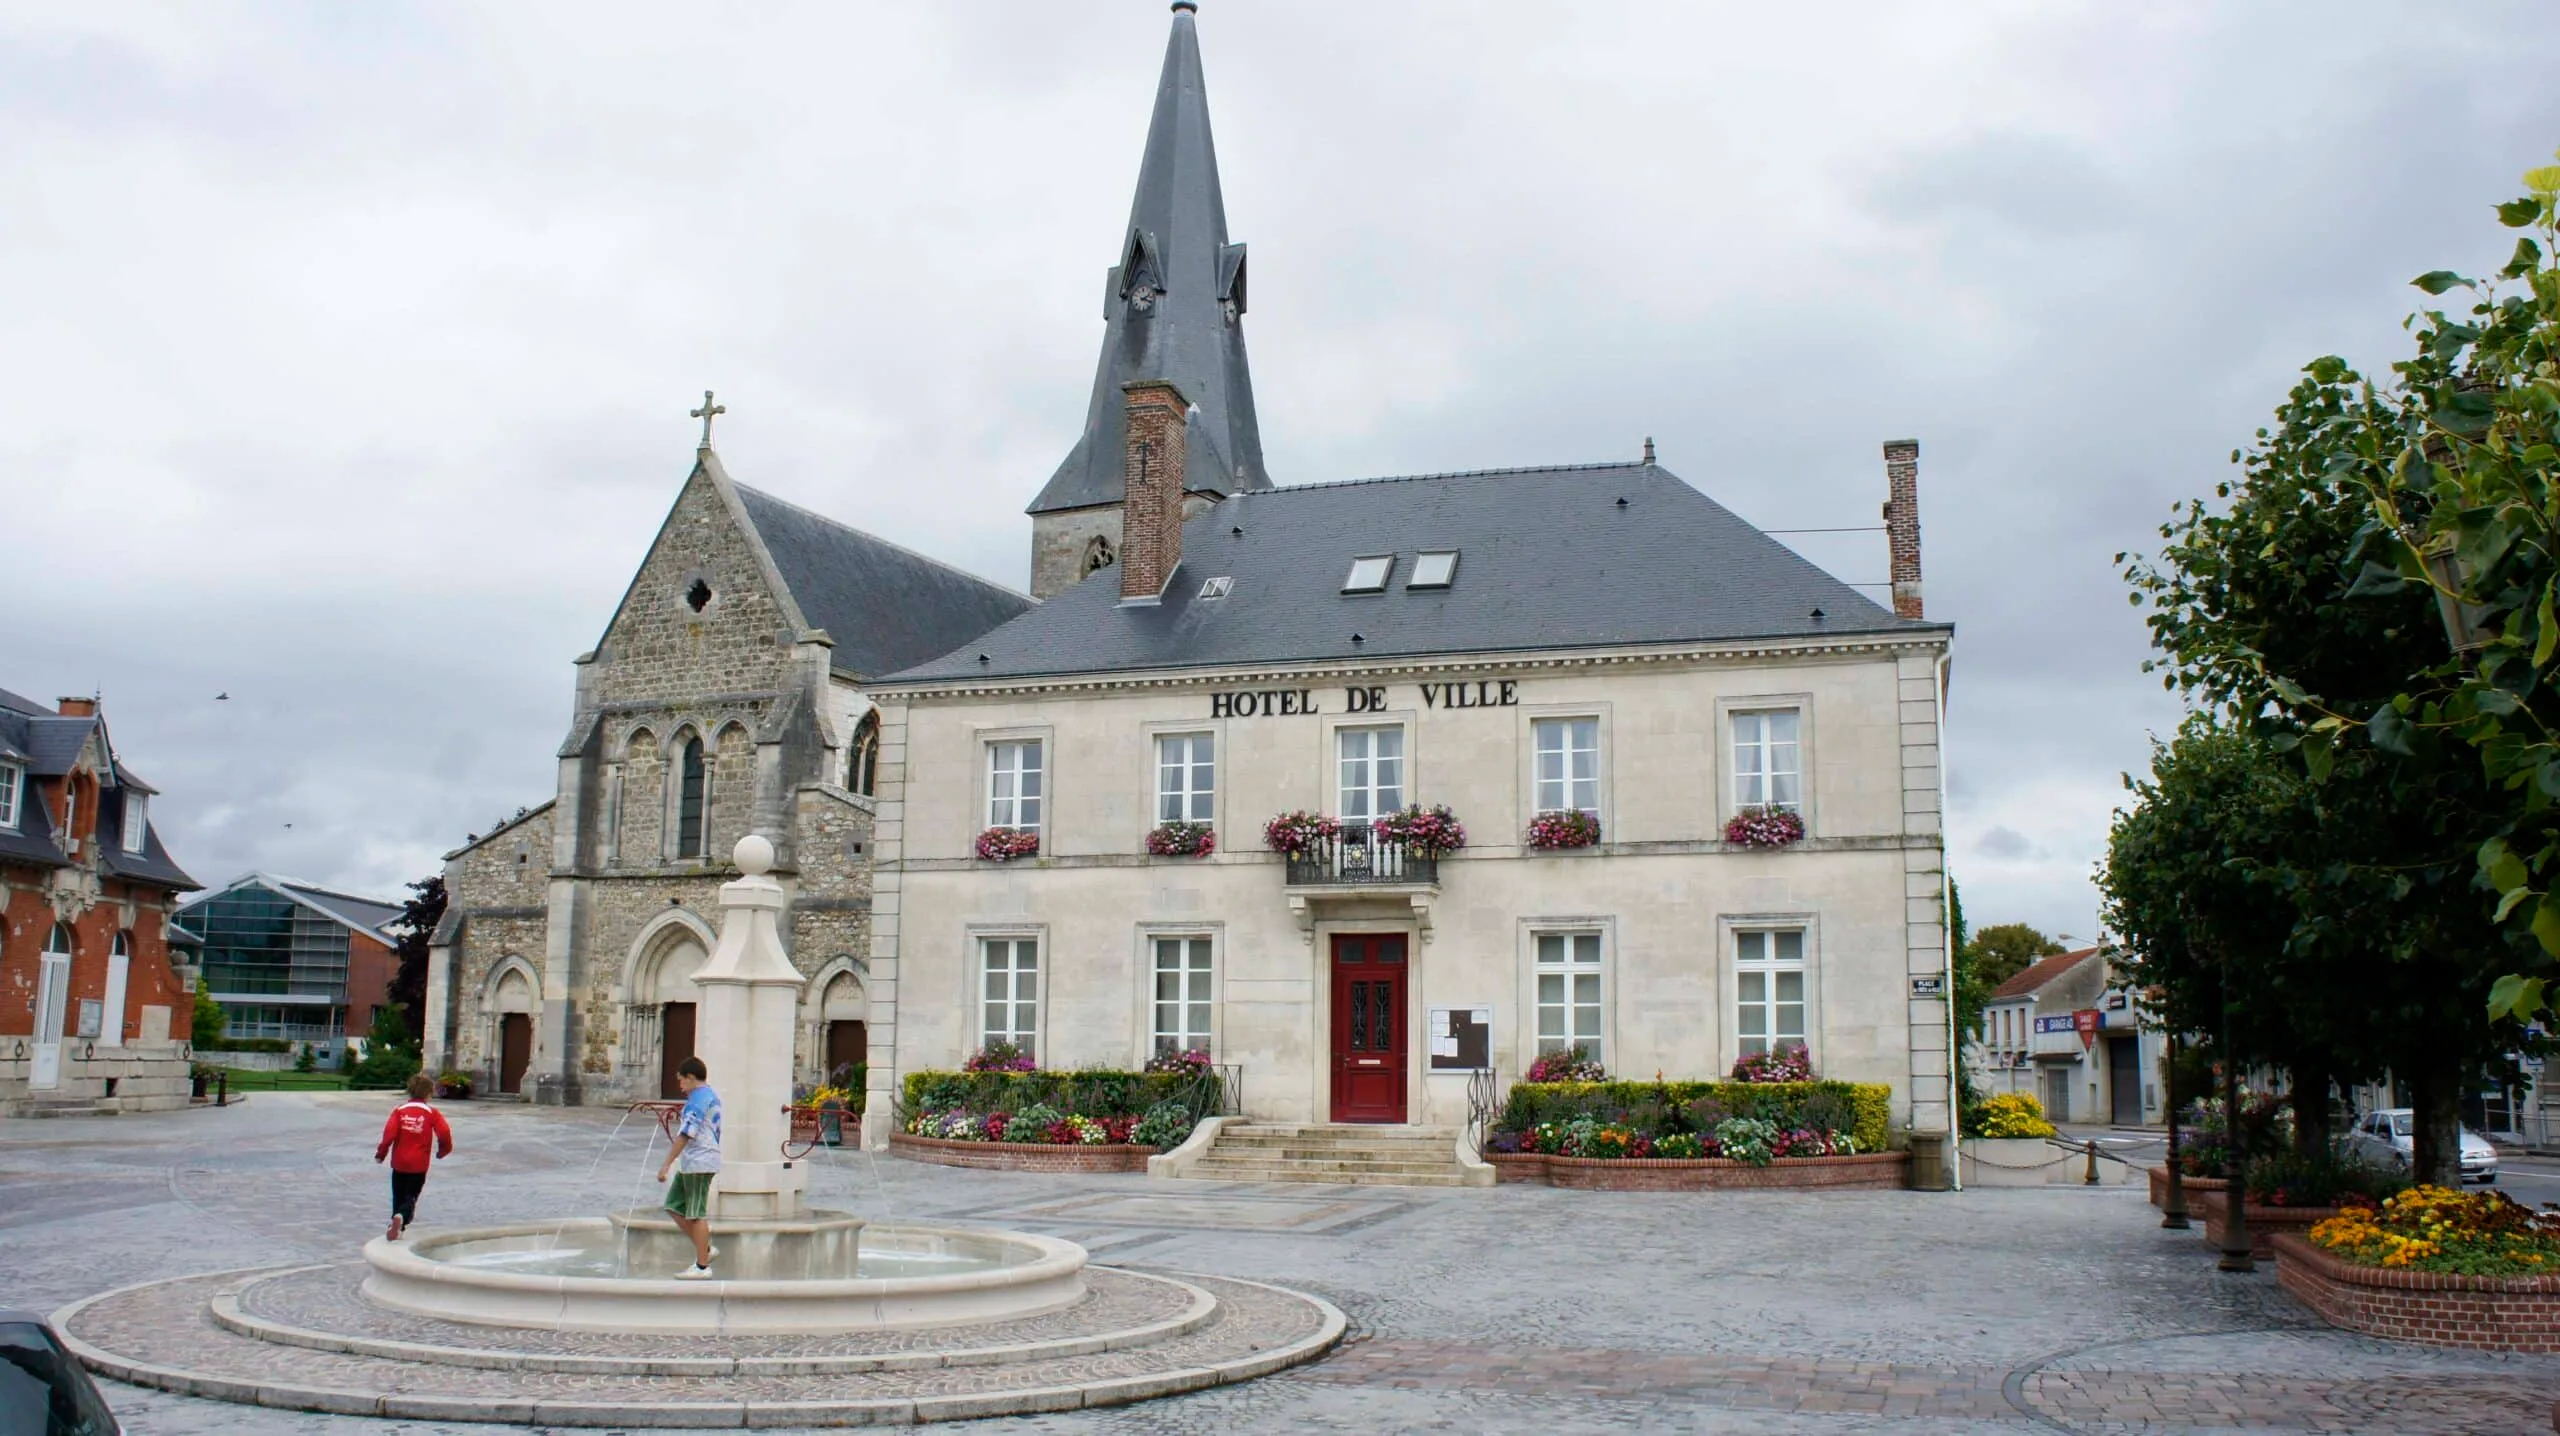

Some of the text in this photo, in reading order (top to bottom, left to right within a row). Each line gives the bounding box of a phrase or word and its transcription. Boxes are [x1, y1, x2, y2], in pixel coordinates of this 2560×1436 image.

[1211, 679, 1519, 718] HOTEL DE VILLE
